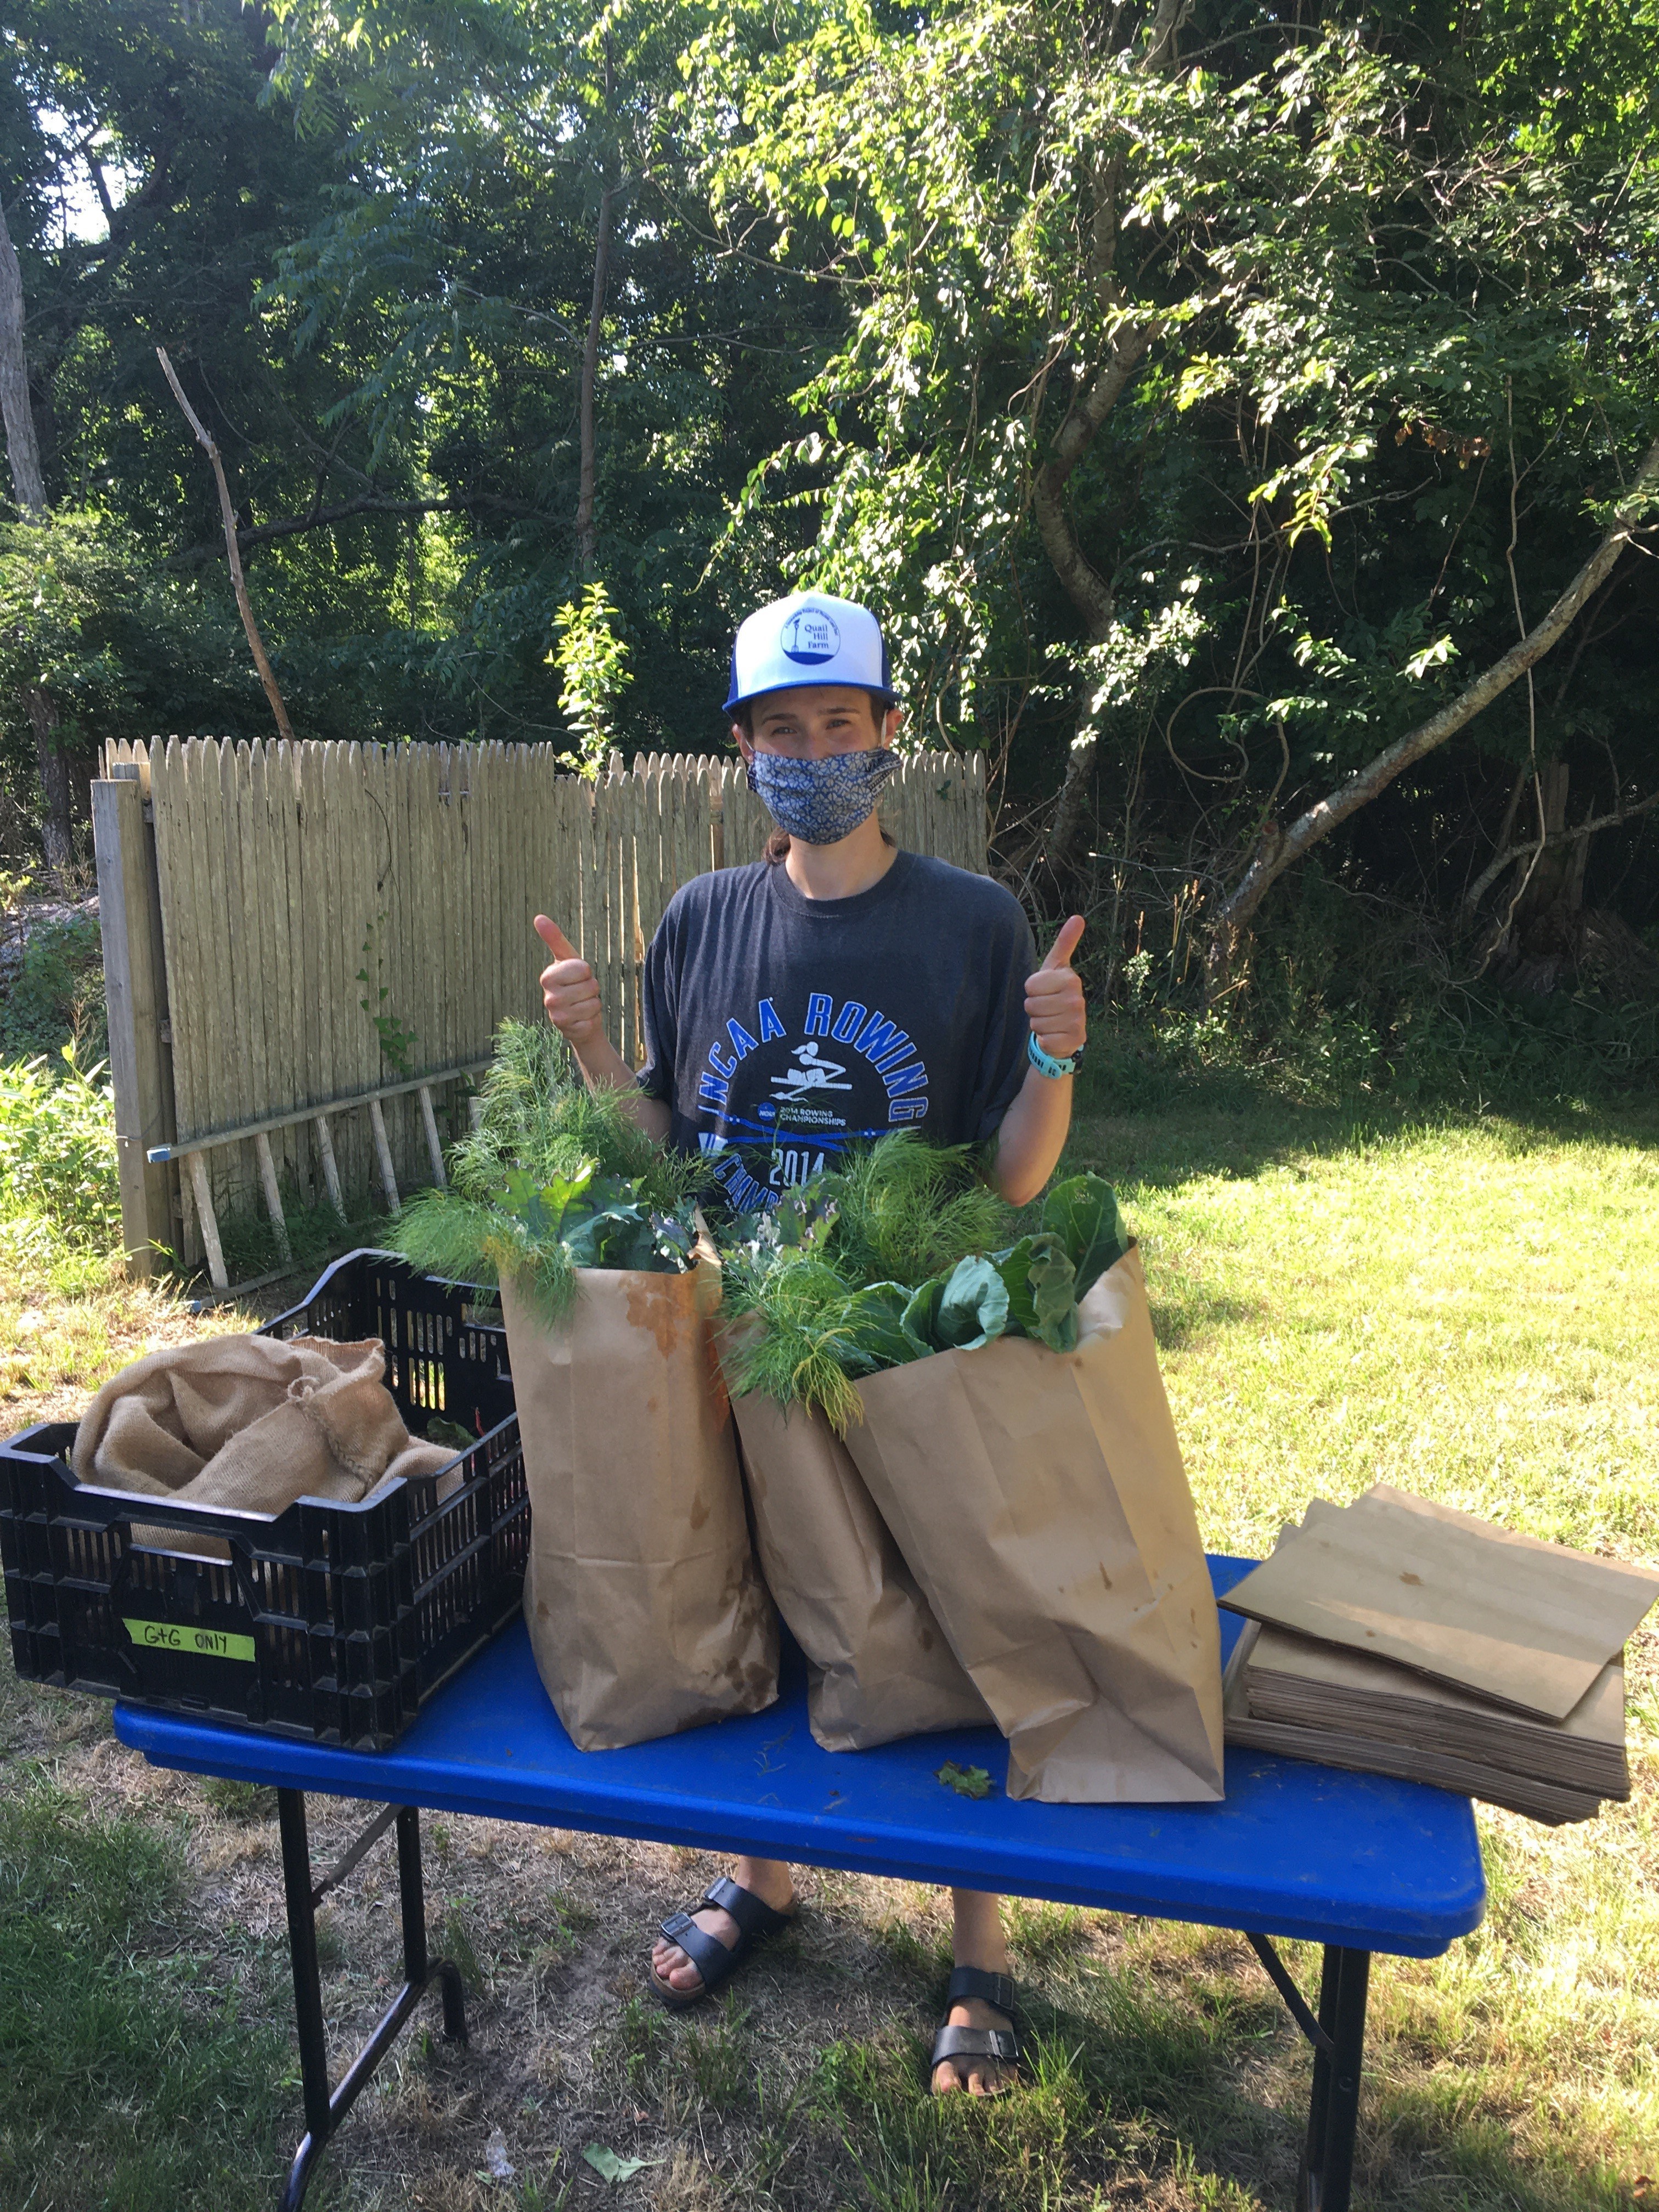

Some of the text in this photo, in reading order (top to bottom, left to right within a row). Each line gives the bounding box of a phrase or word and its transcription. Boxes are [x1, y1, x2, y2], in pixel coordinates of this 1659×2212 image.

[804, 624, 828, 634] Quail
[698, 992, 929, 1121] NCAA ROWING
[780, 1106, 833, 1118] 2014 ROWING
[780, 1113, 846, 1126] CHAMPIONSHIPS
[769, 1148, 825, 1188] 2014
[144, 1625, 181, 1646] G+G
